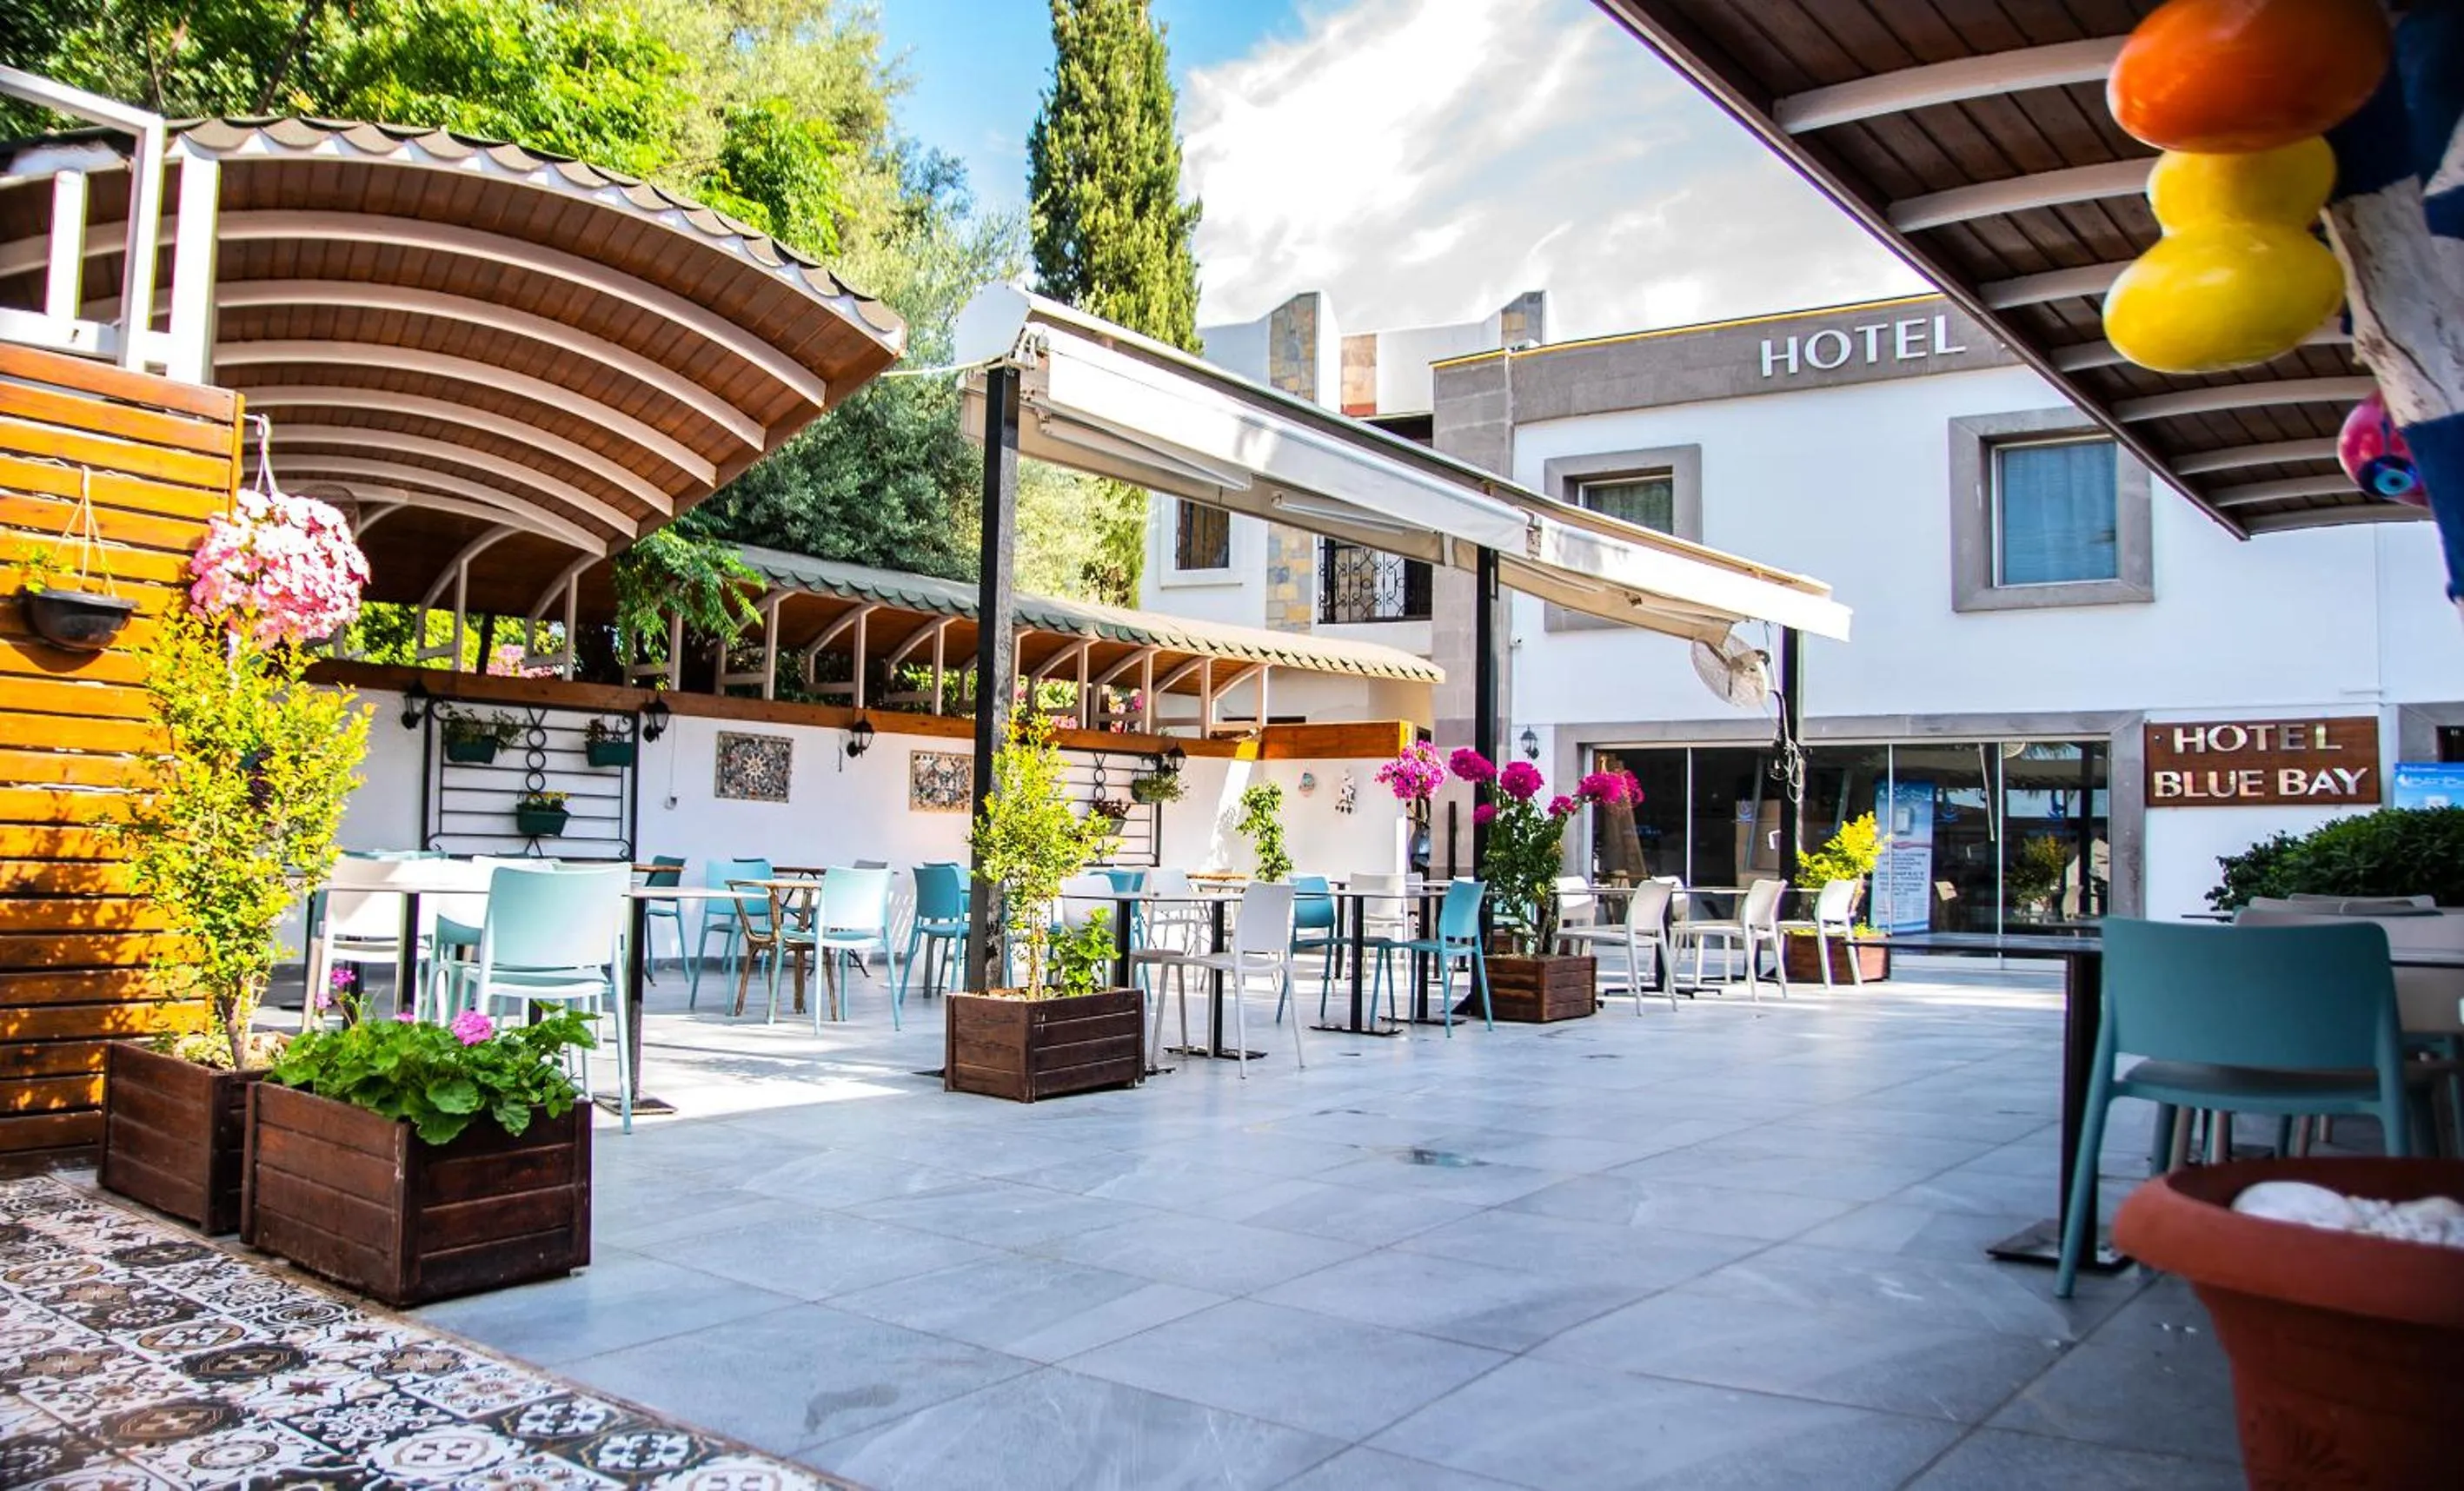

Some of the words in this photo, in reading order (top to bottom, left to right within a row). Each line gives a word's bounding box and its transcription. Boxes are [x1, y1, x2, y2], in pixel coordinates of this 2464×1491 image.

[1761, 315, 1967, 377] HOTEL
[2174, 724, 2342, 753] HOTEL
[2154, 770, 2264, 798] BLUE
[2278, 767, 2368, 797] BAY
